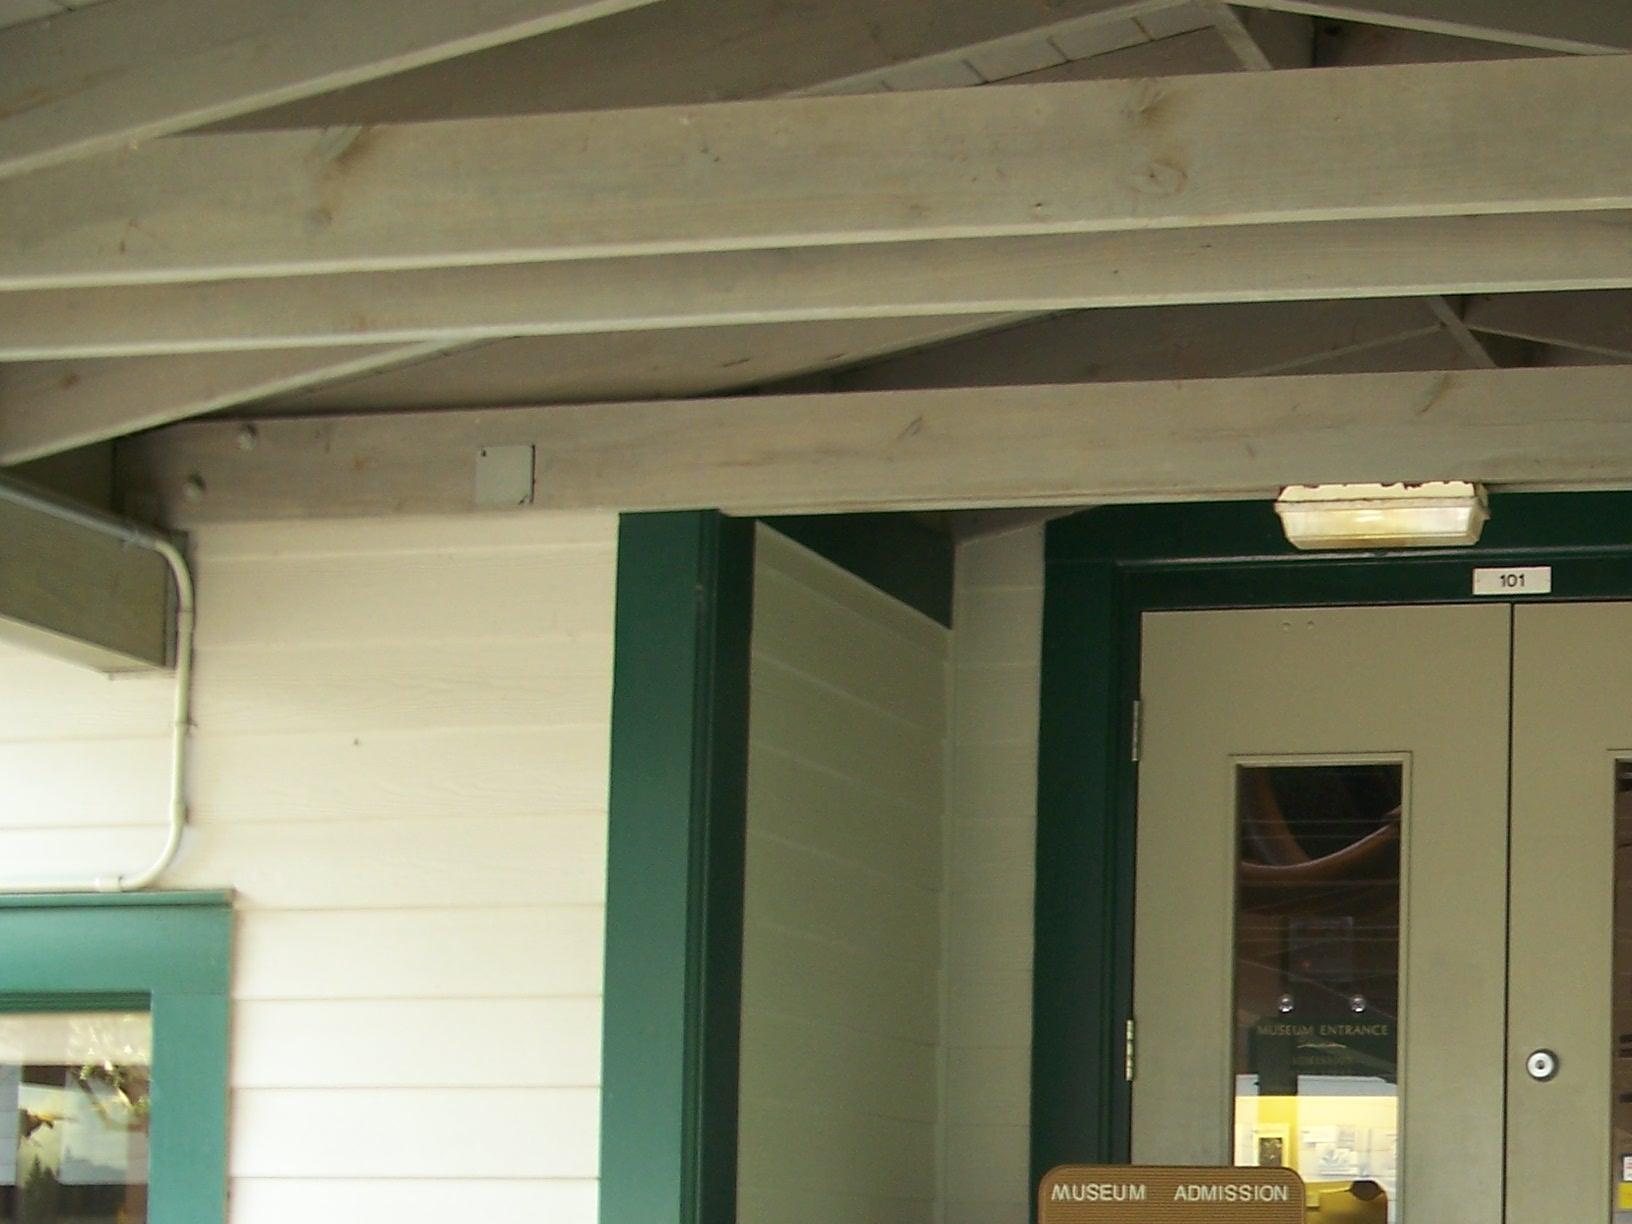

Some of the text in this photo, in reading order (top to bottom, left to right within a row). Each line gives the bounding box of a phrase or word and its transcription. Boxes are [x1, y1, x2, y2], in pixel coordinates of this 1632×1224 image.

[1500, 573, 1525, 588] 101
[1256, 1024, 1389, 1036] MUSEUM ENTRANCE
[1050, 1184, 1289, 1202] MUSEUM ADMISSION
